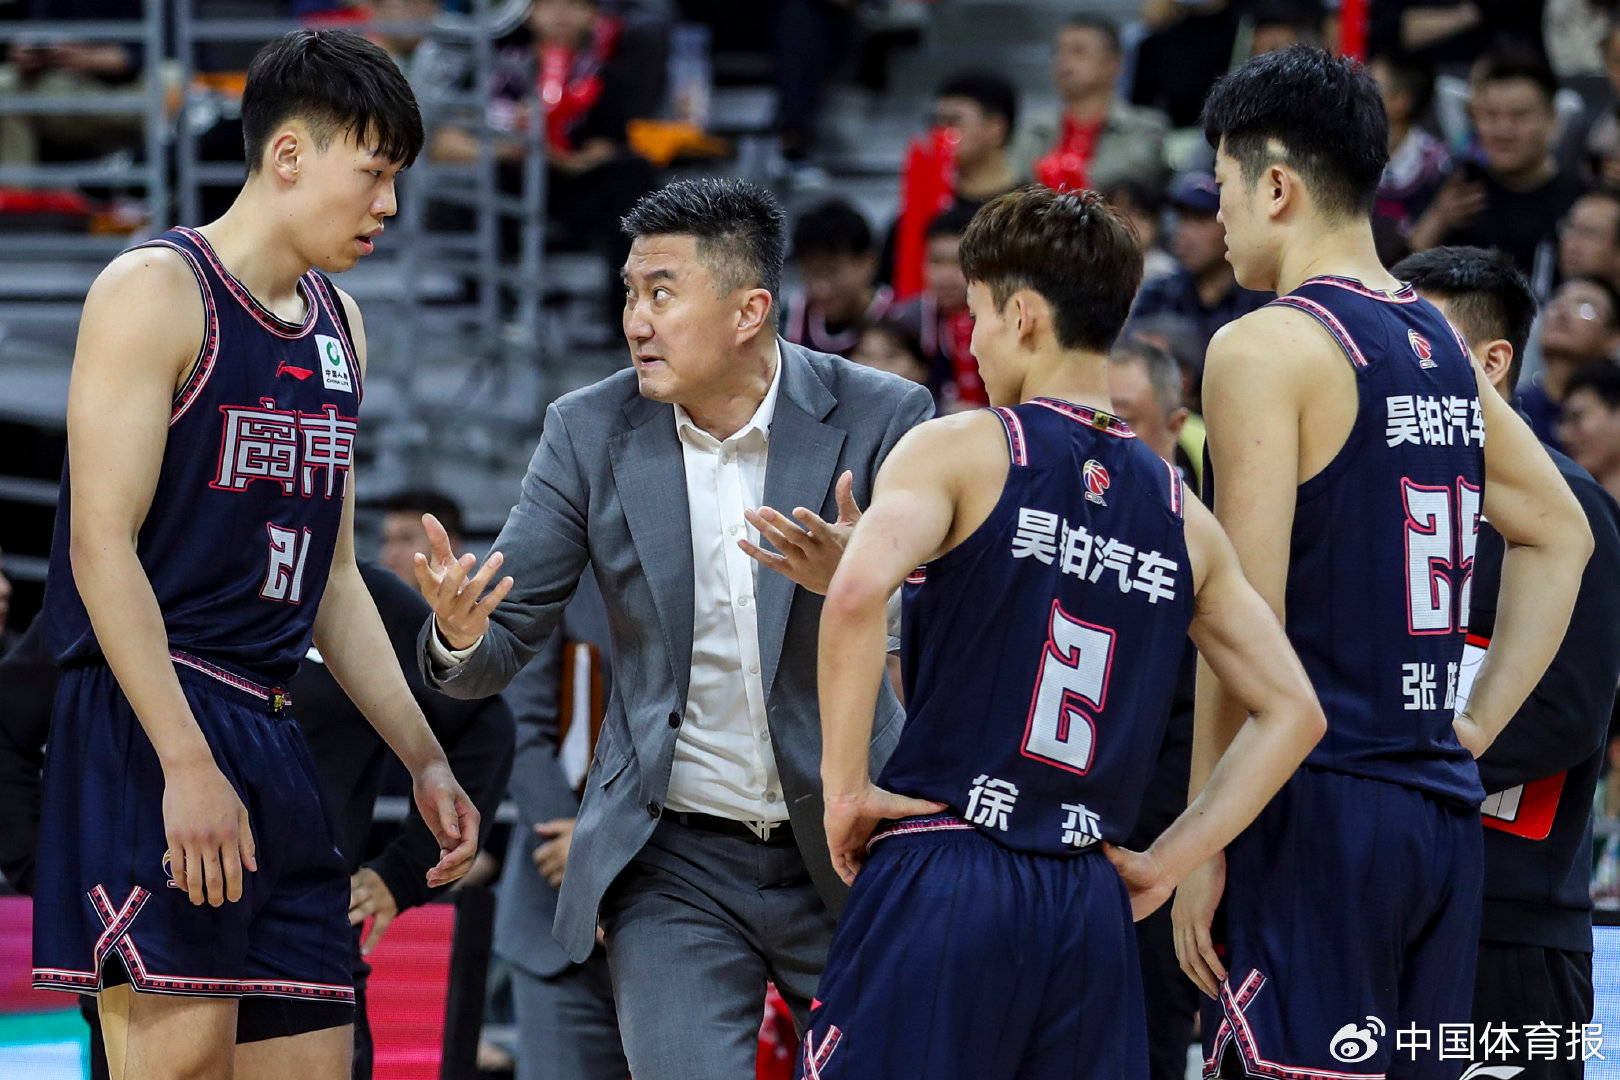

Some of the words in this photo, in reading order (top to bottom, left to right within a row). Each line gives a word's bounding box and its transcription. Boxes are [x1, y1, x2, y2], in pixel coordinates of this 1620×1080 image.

[1385, 394, 1486, 448] 昊铂汽车
[259, 522, 312, 604] 21
[1011, 506, 1178, 604] 昊铂汽车
[1020, 598, 1117, 776] 2
